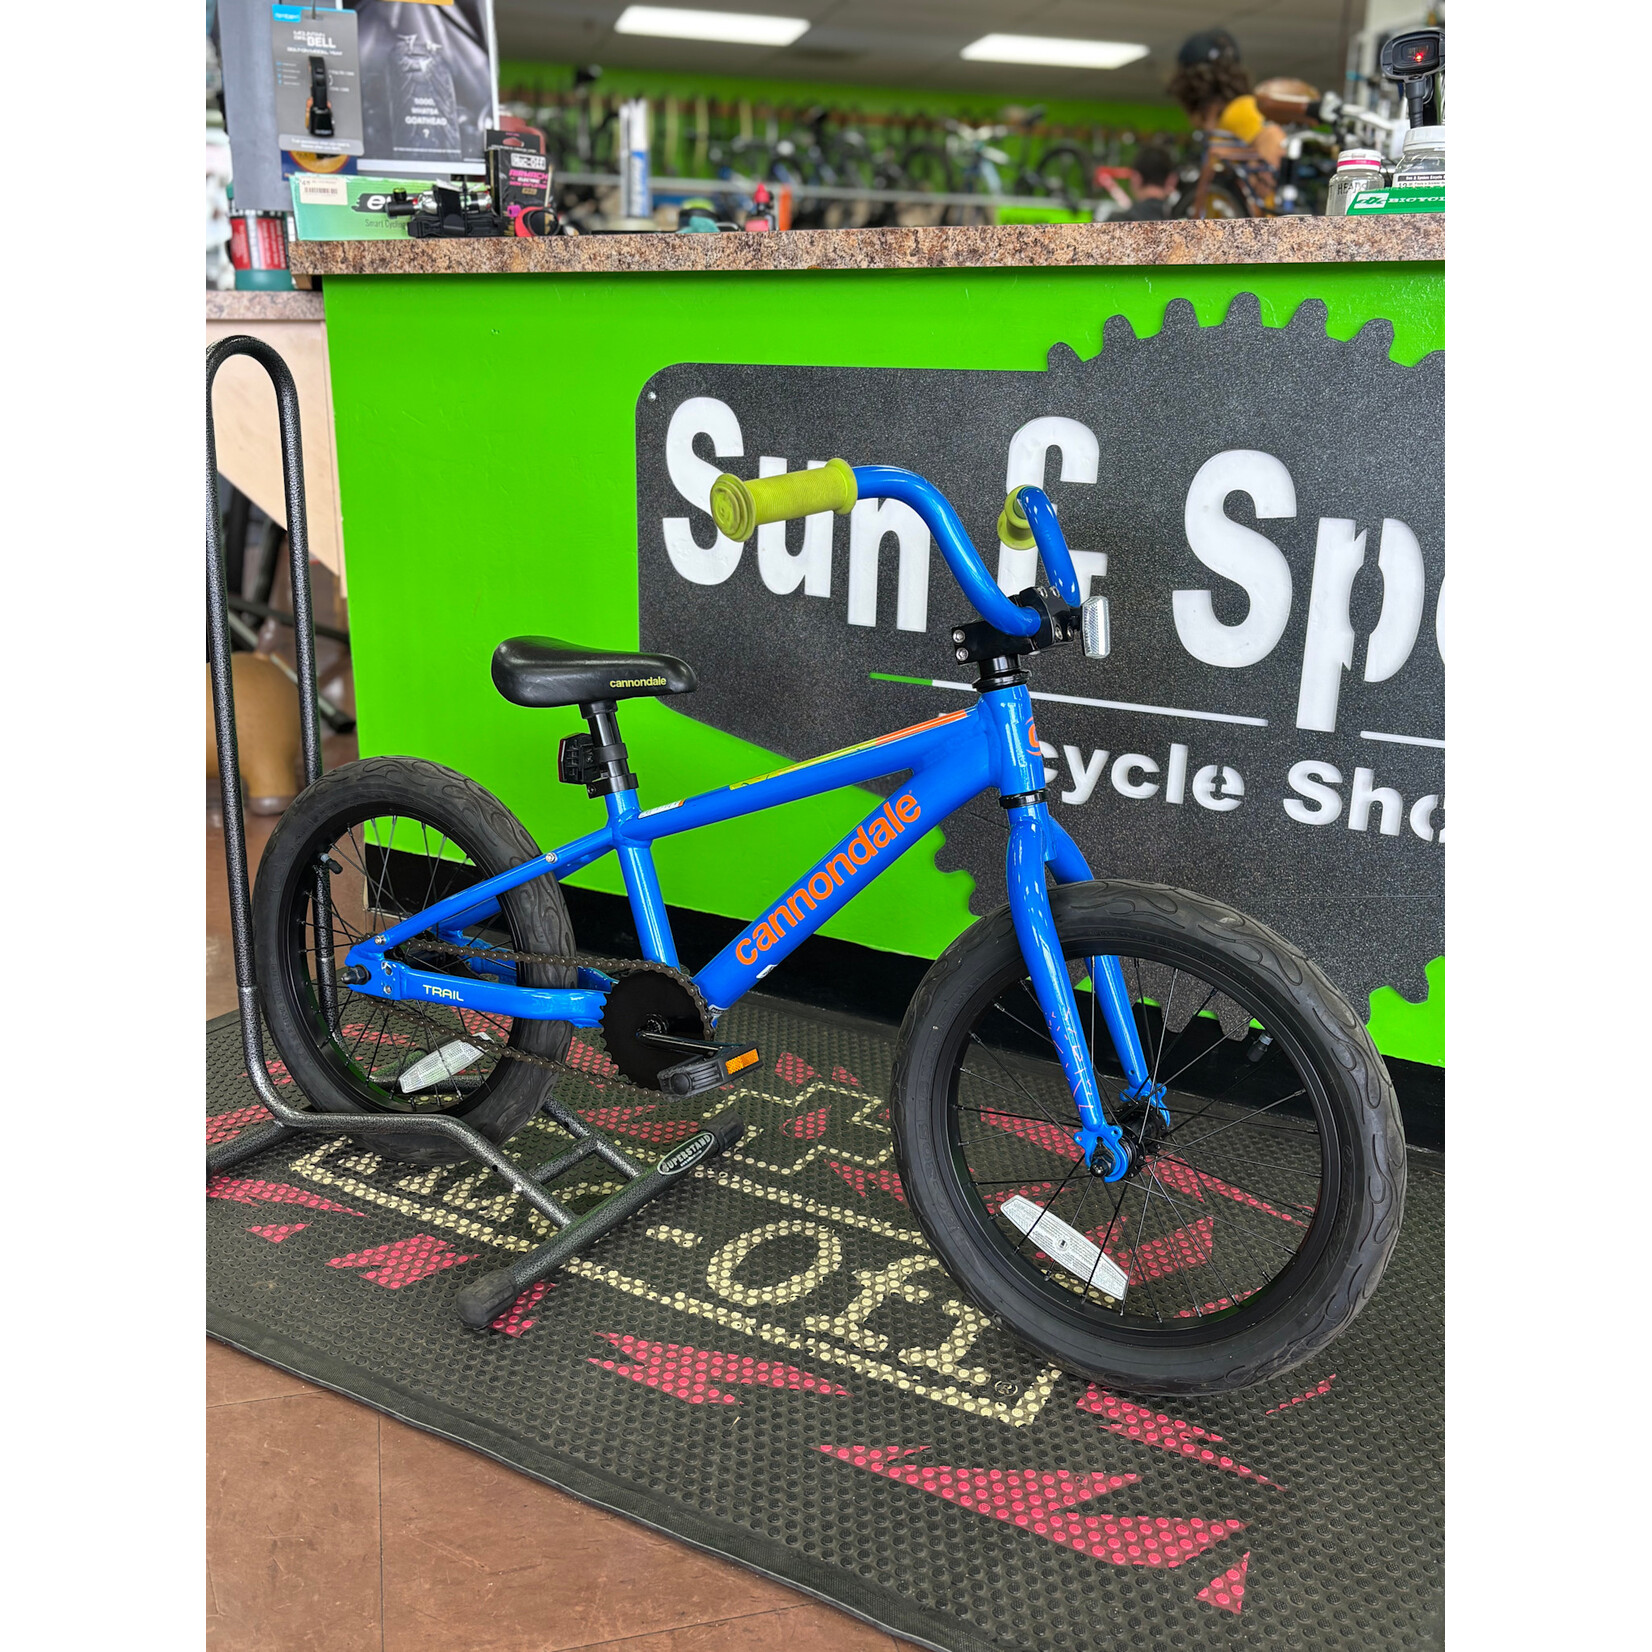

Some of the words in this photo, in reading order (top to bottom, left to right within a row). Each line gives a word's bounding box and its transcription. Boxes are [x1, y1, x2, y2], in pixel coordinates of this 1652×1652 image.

[662, 396, 931, 633] Sun
[1172, 449, 1445, 732] Sp
[609, 676, 667, 688] cannondale
[735, 793, 922, 966] cannondale
[422, 984, 465, 1002] TRAIL
